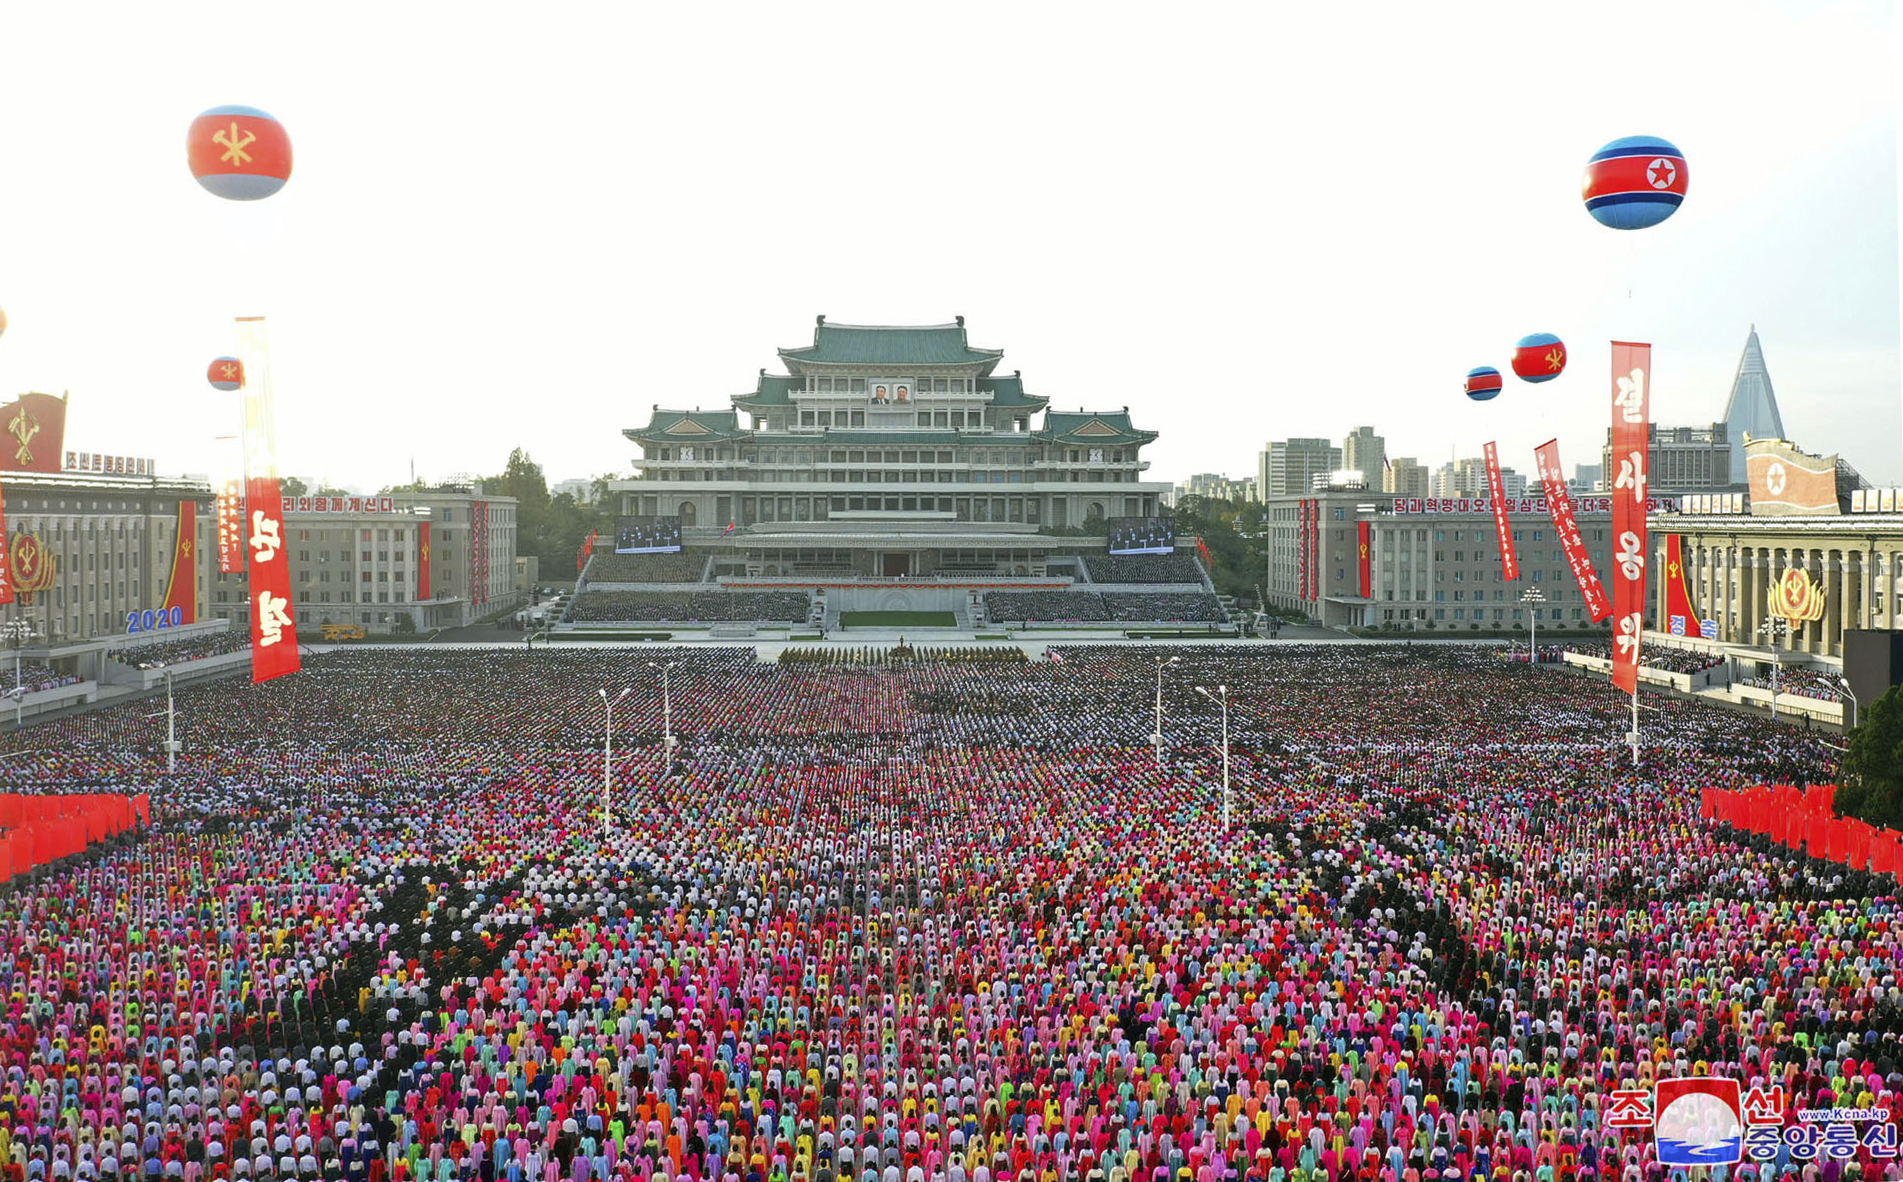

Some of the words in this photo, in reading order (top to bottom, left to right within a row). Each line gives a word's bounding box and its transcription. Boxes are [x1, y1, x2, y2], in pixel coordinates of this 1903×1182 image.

[282, 497, 311, 512] 리와
[1615, 368, 1647, 666] 결사옹위
[127, 606, 182, 634] 2020
